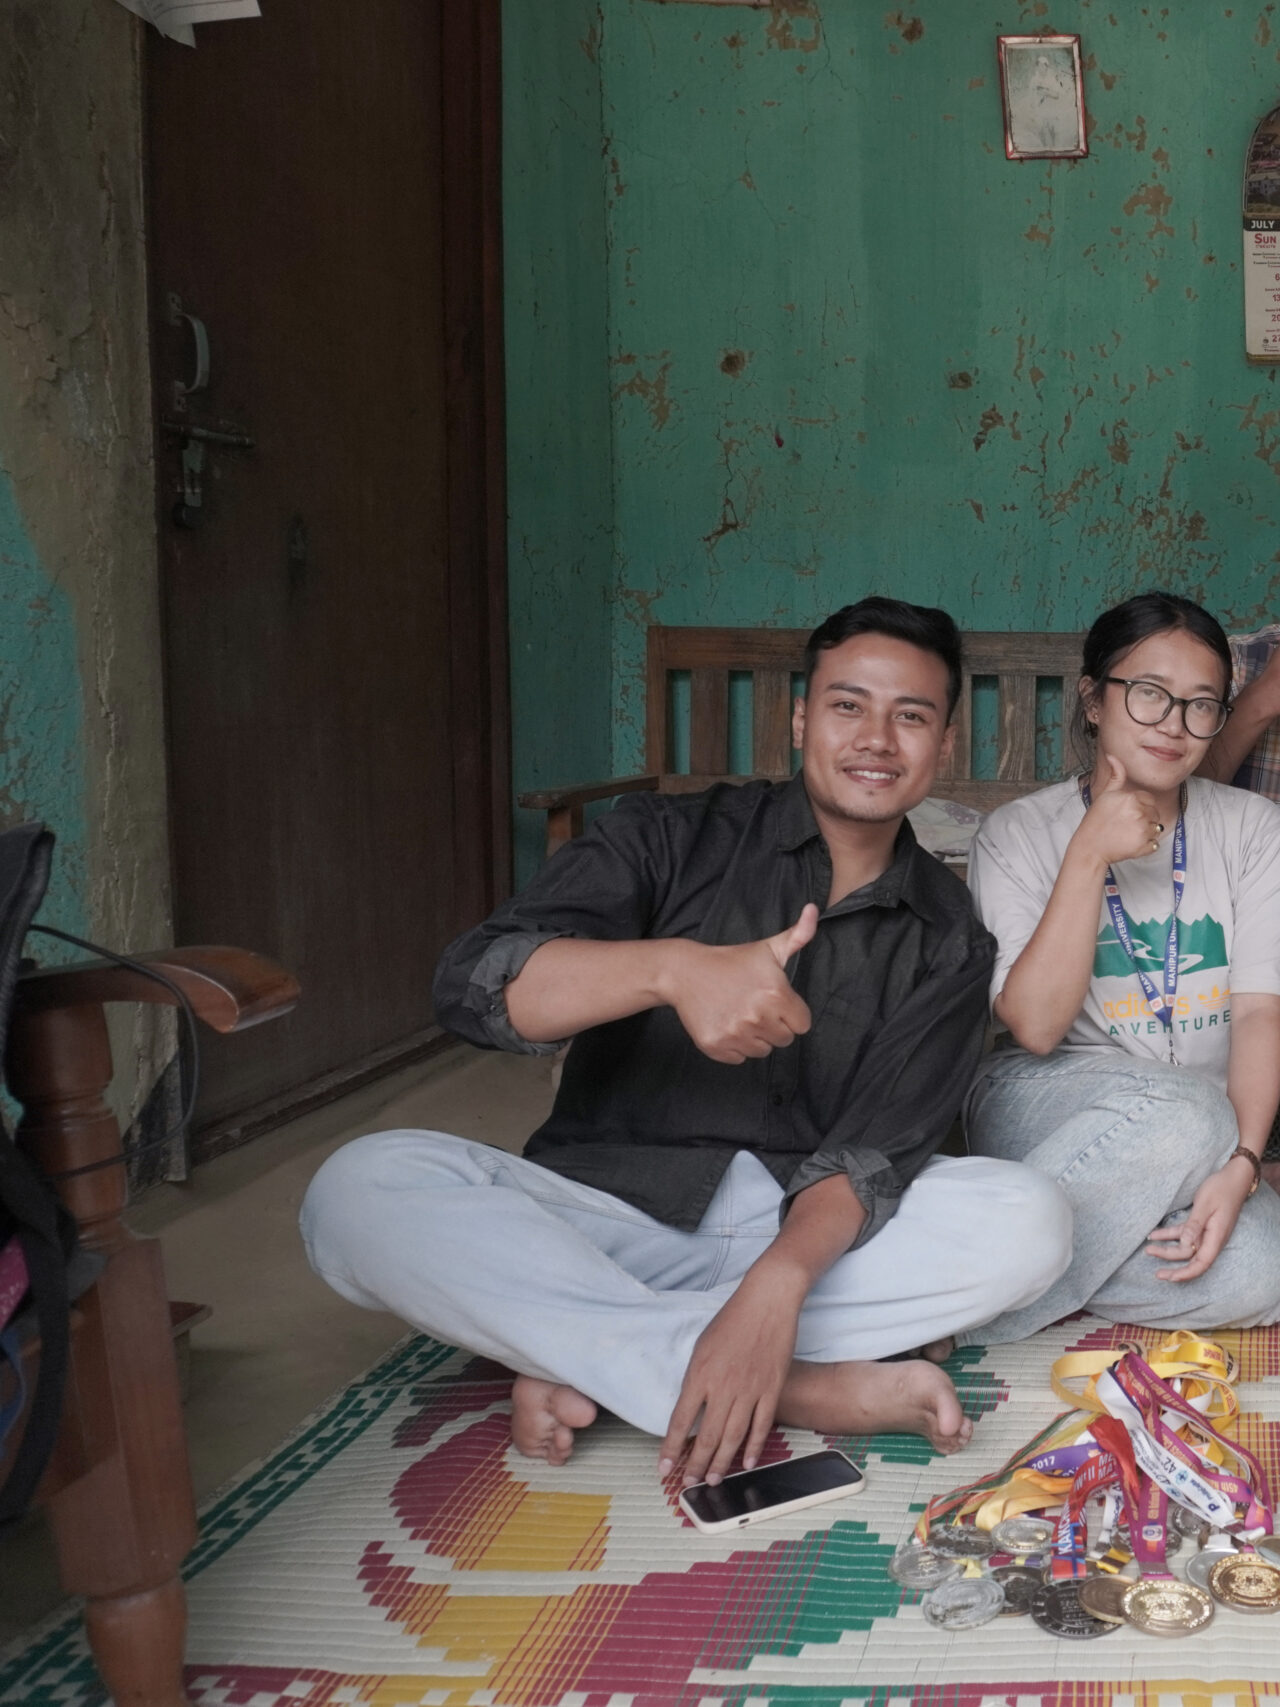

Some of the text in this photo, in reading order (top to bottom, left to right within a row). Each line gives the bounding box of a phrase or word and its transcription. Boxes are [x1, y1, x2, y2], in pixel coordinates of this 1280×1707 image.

[1251, 220, 1275, 229] JULY
[1275, 273, 1280, 281] 6
[1272, 294, 1280, 302] 13
[1168, 944, 1177, 987] MANIPUR
[1031, 1455, 1056, 1471] 2017
